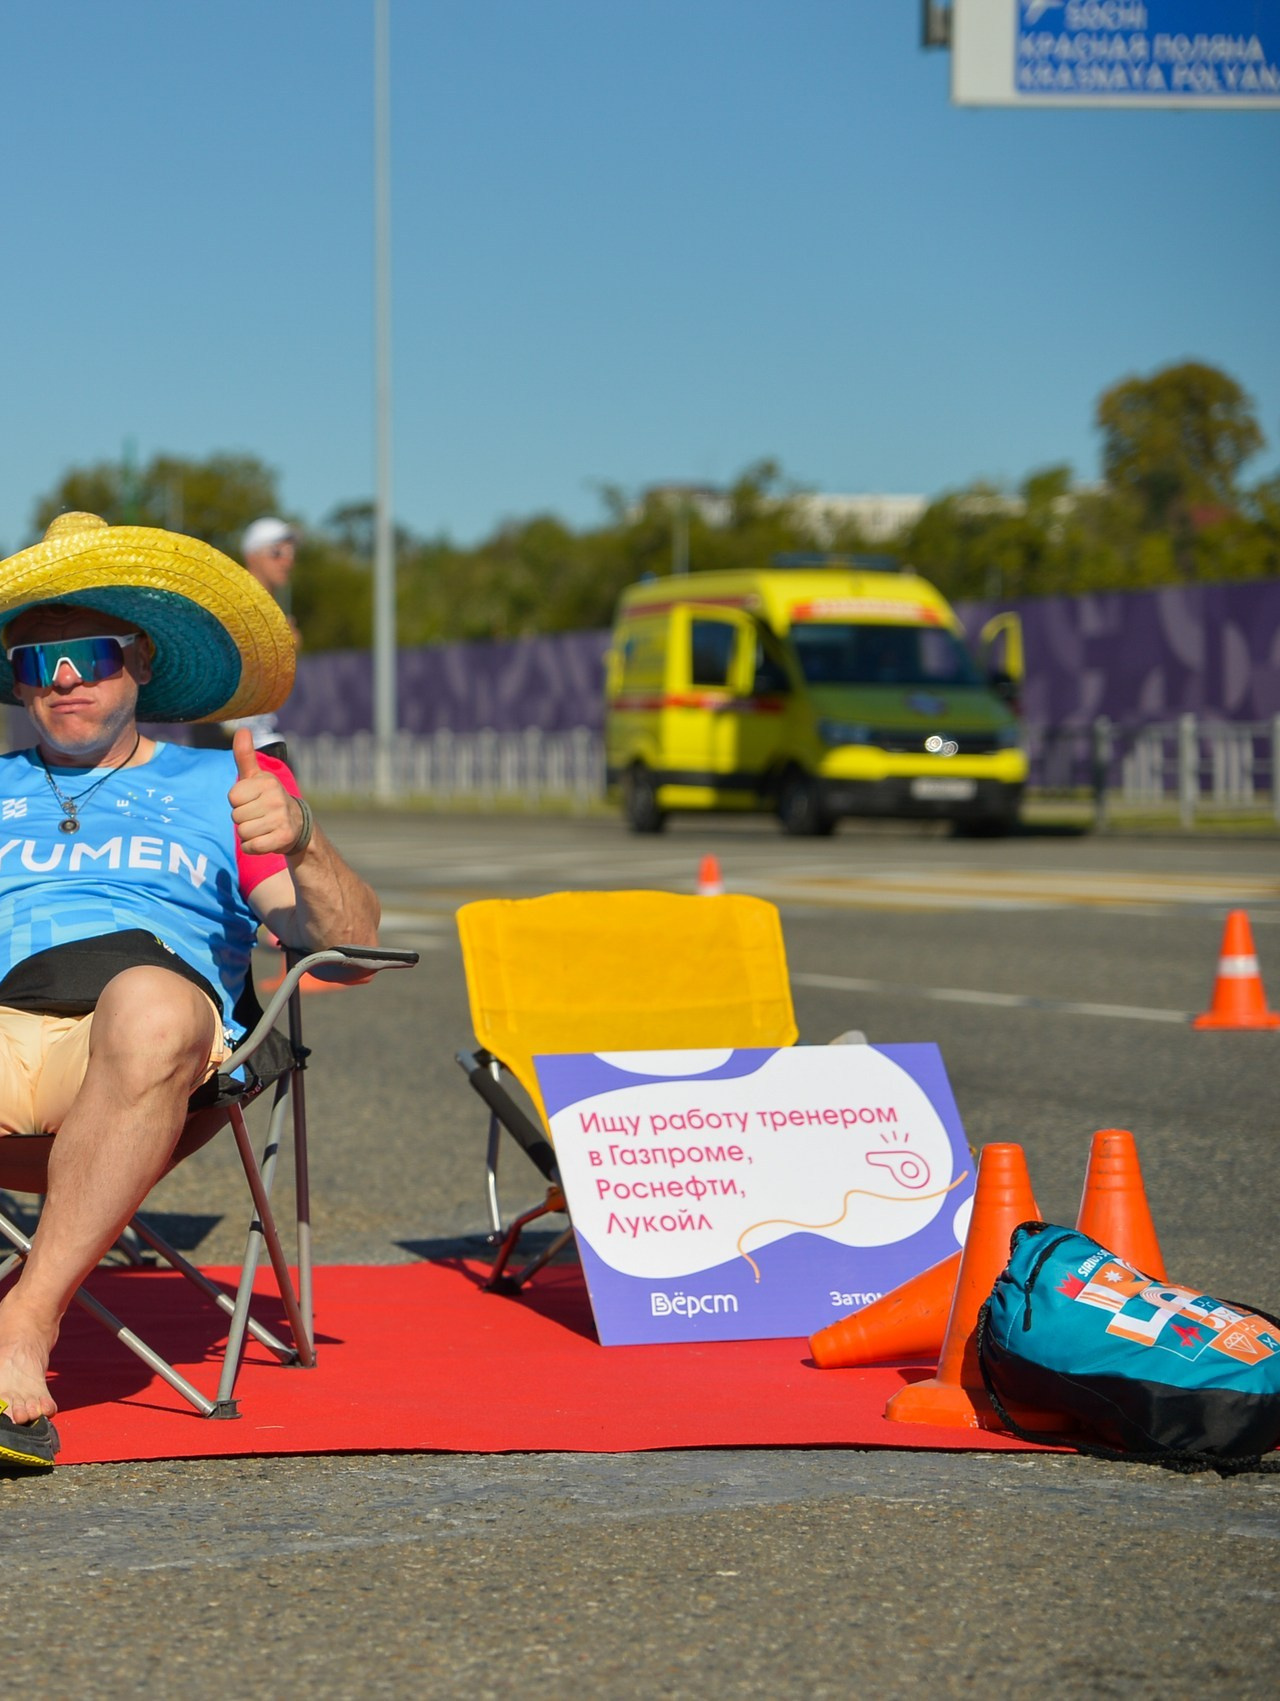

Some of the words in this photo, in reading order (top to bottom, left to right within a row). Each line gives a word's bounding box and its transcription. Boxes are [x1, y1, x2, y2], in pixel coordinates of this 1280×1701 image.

[1020, 33, 1149, 61] КРАСНАЯ
[1154, 33, 1265, 62] ПОЛЯНА
[1020, 61, 1165, 90] KRASNAYA
[1173, 61, 1280, 91] POLYAN
[579, 1111, 640, 1137] Ищу
[650, 1108, 749, 1135] работу
[757, 1105, 898, 1133] тренером
[589, 1150, 604, 1167] в
[608, 1144, 753, 1168] Газпроме,
[596, 1175, 746, 1202] Роснефти,
[607, 1208, 713, 1238] Лукойл
